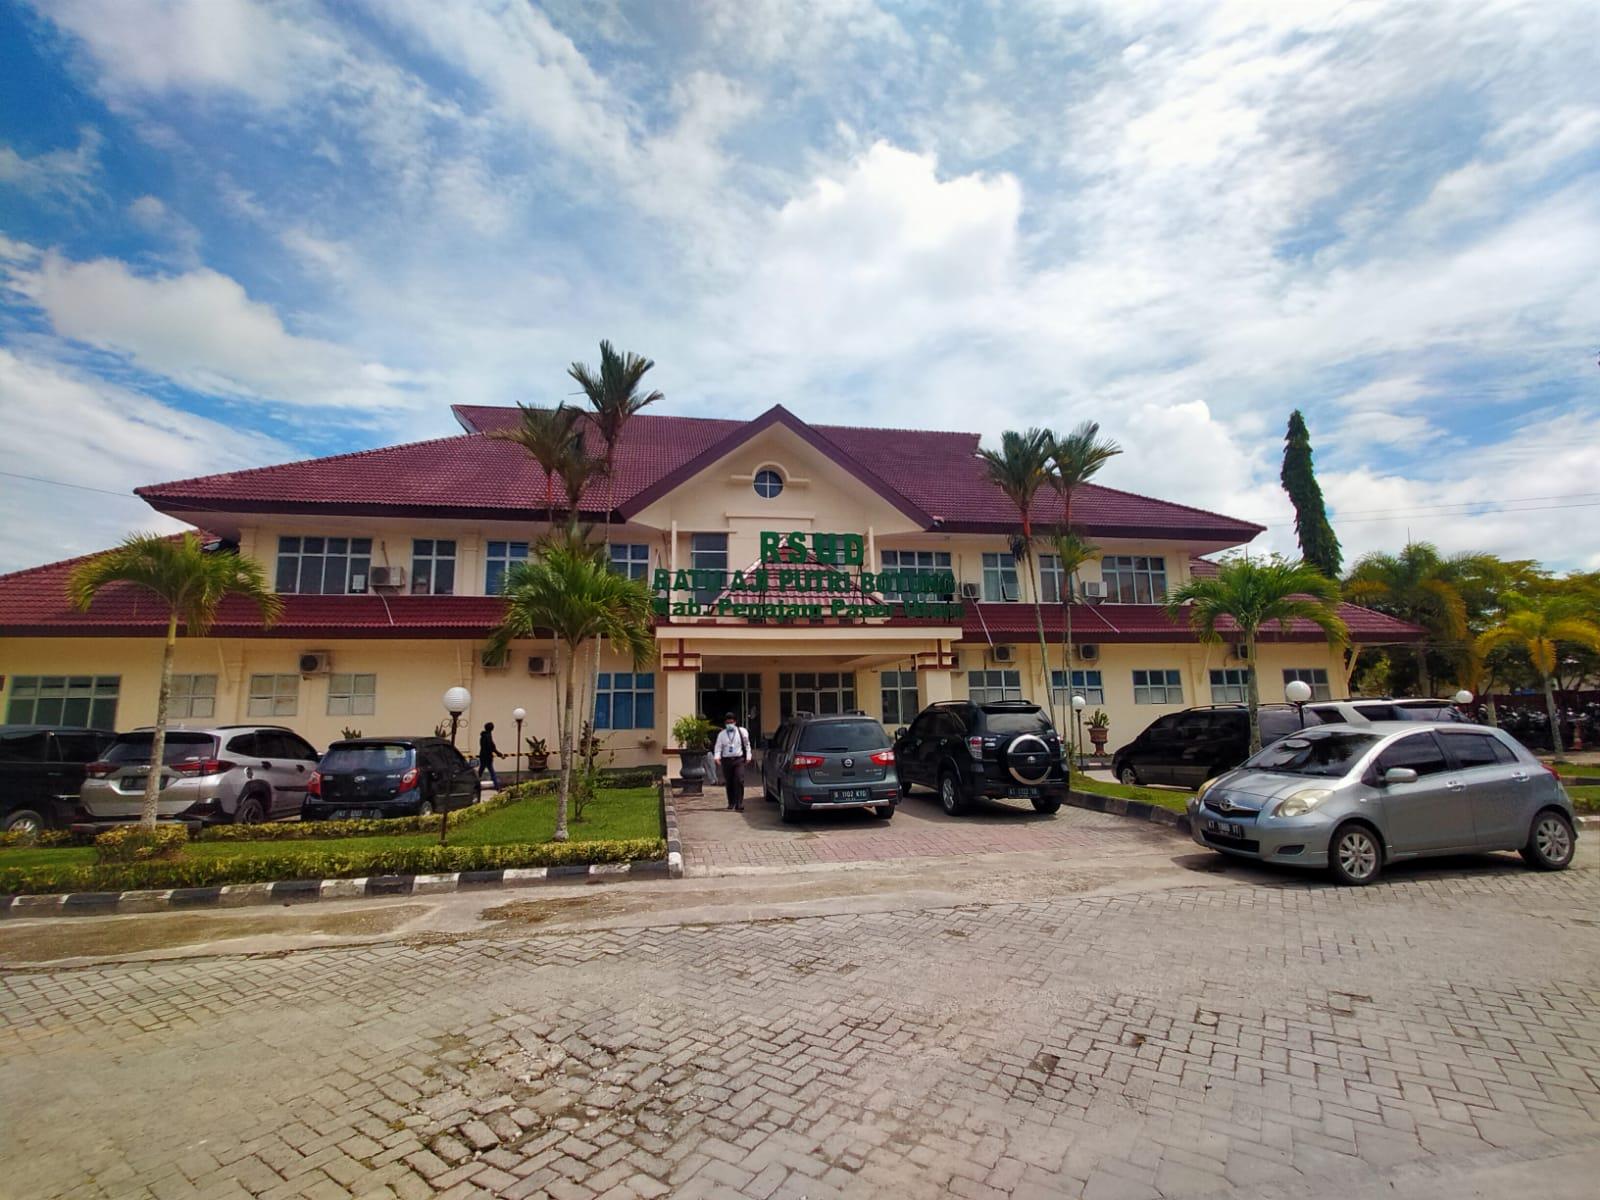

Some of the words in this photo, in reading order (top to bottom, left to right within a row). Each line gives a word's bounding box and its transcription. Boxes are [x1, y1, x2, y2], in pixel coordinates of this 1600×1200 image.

[760, 531, 864, 565] RSUD
[653, 568, 726, 592] RATU
[730, 569, 769, 592] AJI
[778, 570, 851, 593] PUTRI
[719, 598, 823, 622] Penajam
[831, 599, 893, 618] Paser
